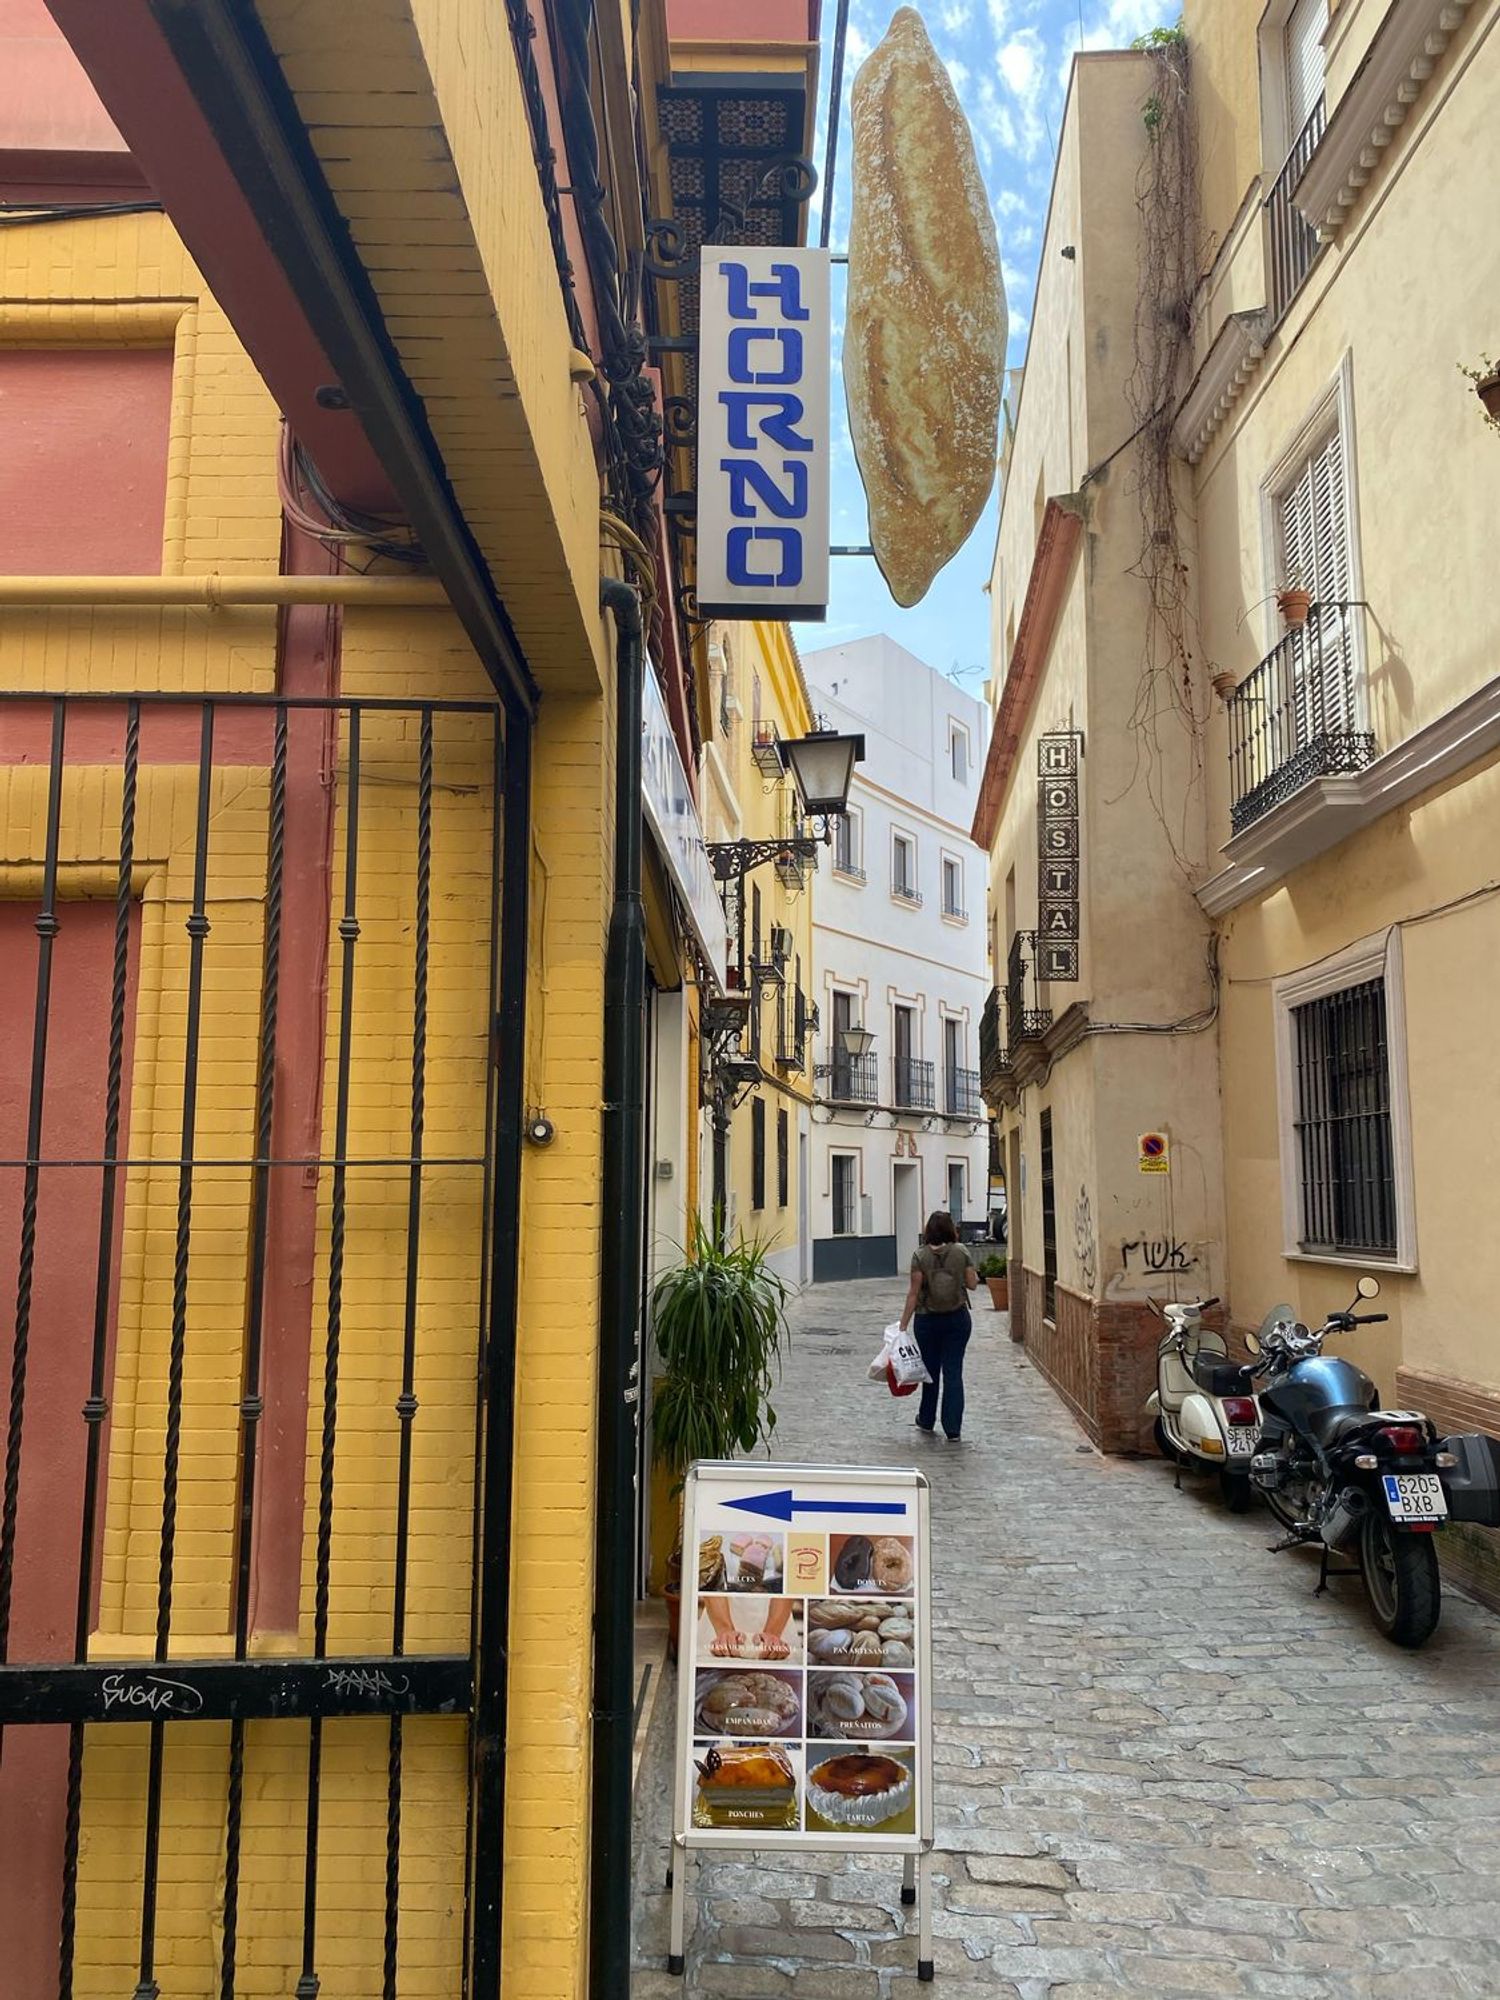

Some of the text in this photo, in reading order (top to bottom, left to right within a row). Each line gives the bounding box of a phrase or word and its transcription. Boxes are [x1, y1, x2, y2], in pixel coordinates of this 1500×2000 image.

[718, 262, 814, 588] HORNO
[1046, 745, 1070, 972] HOSTAL
[1231, 1439, 1256, 1453] 241
[1398, 1477, 1439, 1495] 6205
[1401, 1496, 1433, 1513] BXB
[857, 1578, 887, 1586] DONUTS
[102, 1674, 201, 1713] SUGAR
[725, 1716, 771, 1725] EMPANADAS
[728, 1810, 764, 1819] PONCHES
[846, 1814, 876, 1822] TARTAS
